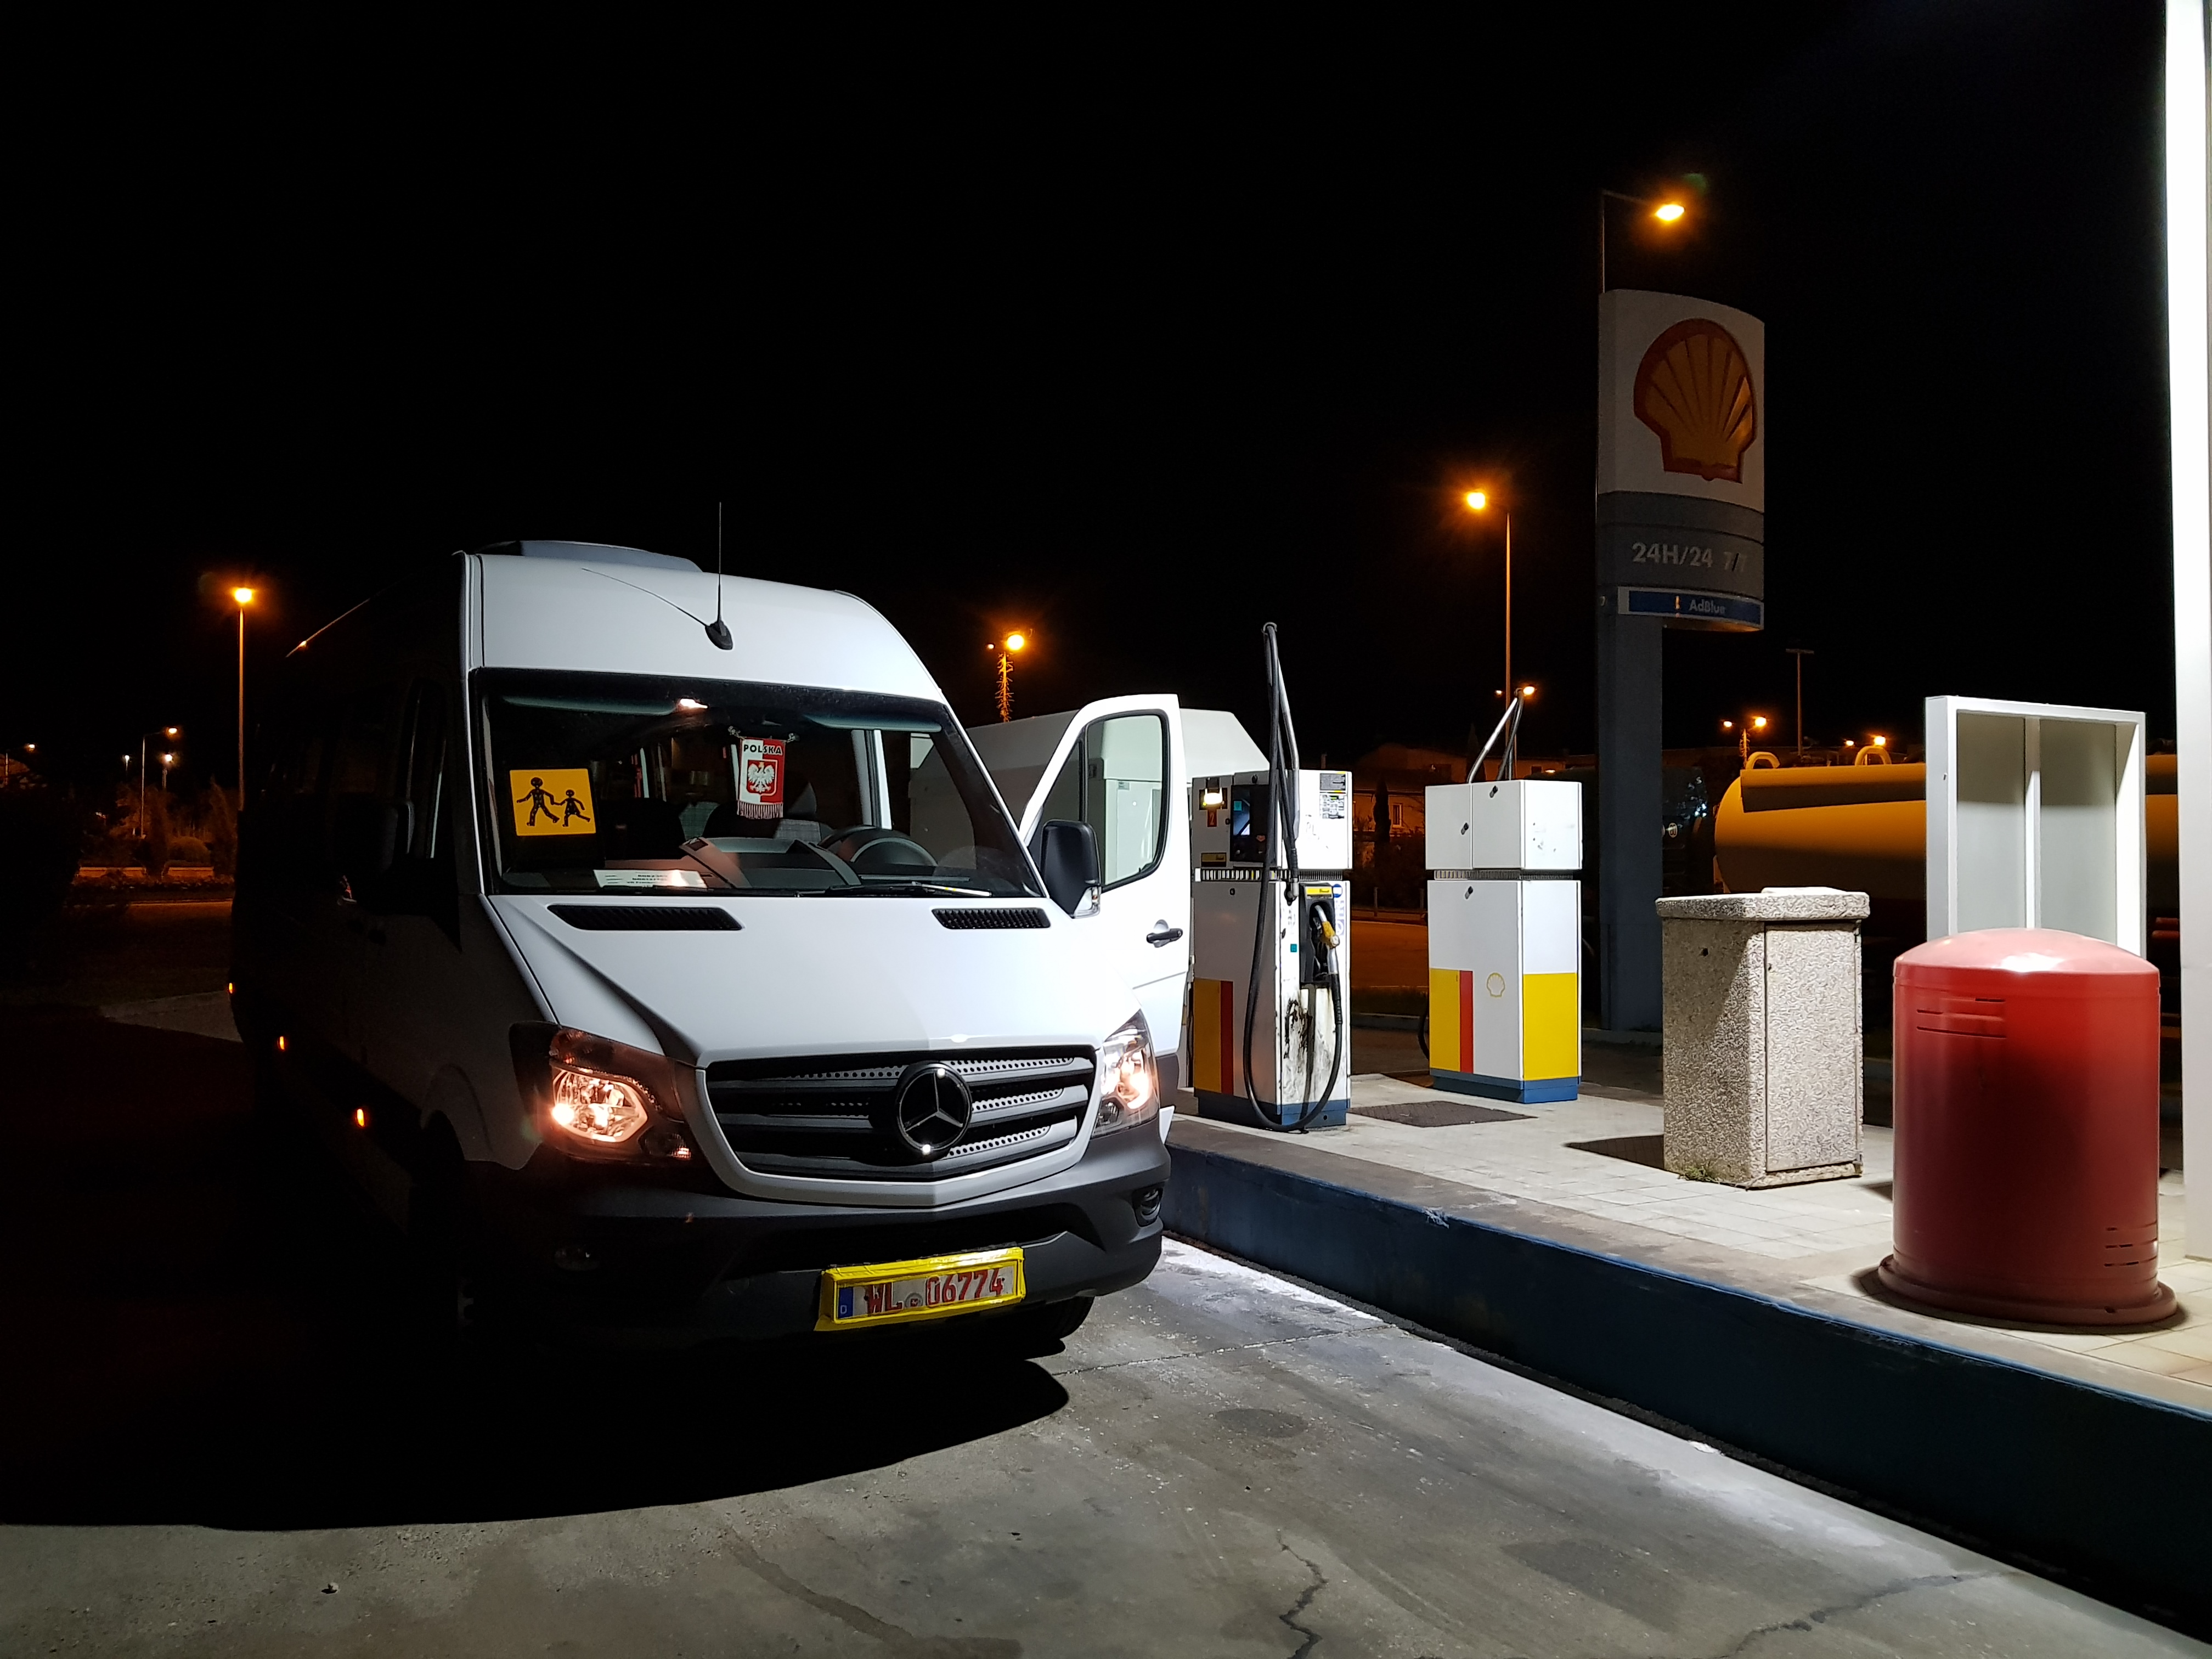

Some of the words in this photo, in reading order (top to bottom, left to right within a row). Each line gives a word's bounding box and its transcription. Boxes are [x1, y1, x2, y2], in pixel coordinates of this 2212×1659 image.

[1632, 541, 1713, 568] 24H/24
[1689, 599, 1726, 614] AdBlue
[743, 744, 782, 754] POLSKA
[840, 1305, 847, 1314] D
[866, 1283, 902, 1314] WL
[926, 1268, 1003, 1305] 06774
